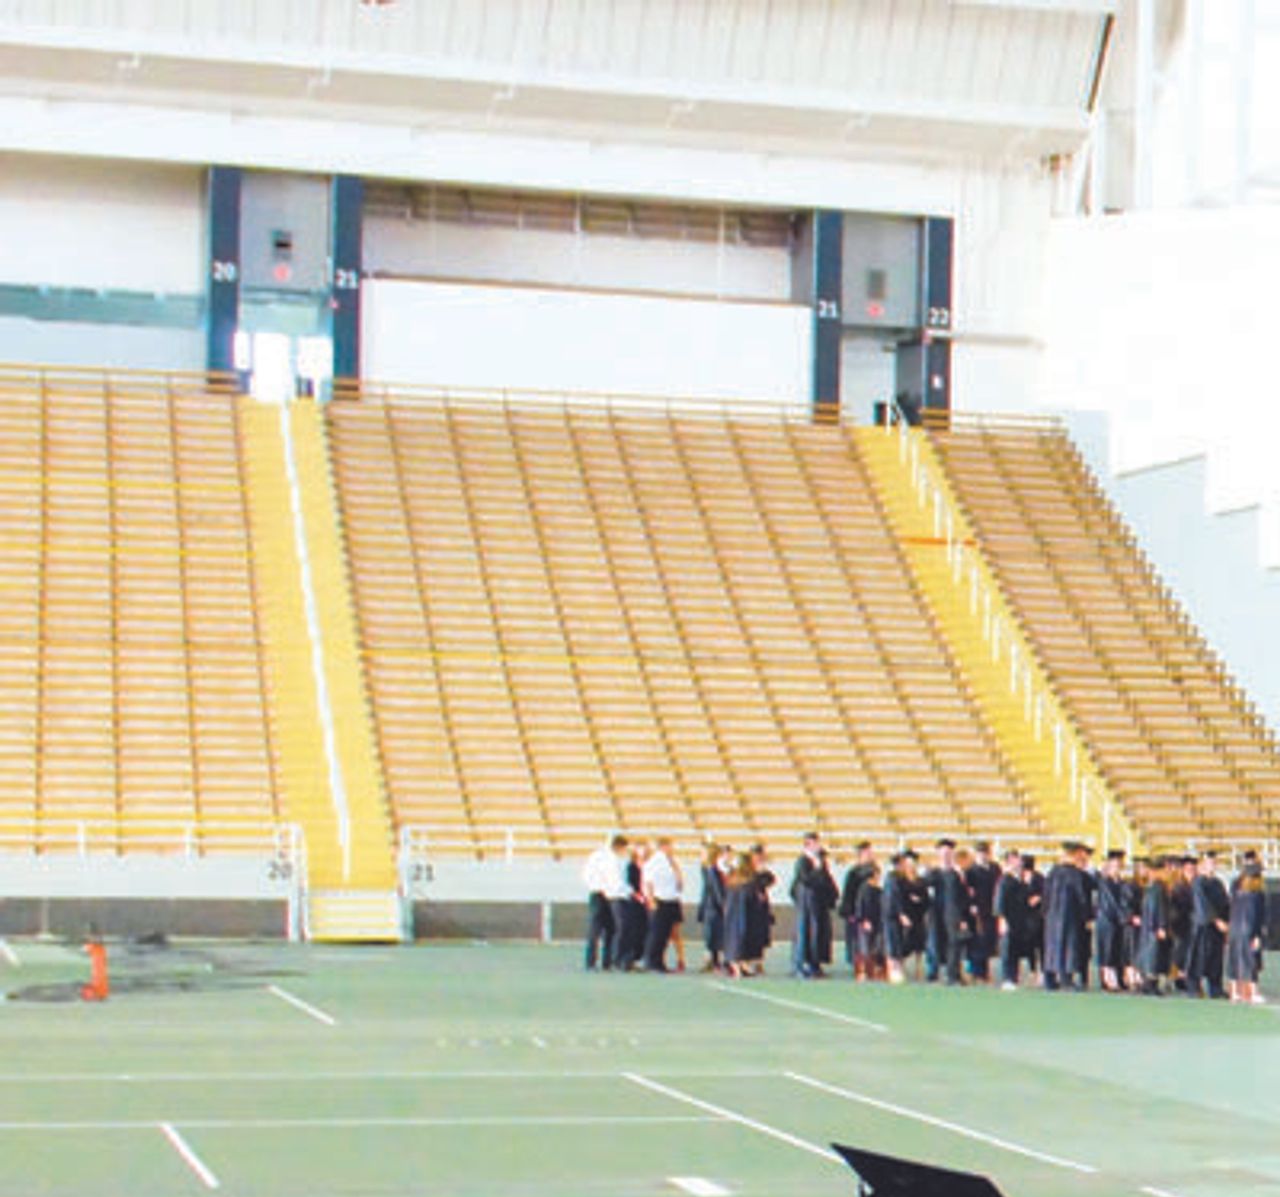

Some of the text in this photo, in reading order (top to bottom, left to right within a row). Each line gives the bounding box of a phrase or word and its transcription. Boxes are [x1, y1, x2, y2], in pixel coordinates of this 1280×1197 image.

[335, 268, 357, 289] 21
[818, 300, 837, 318] 21
[928, 307, 949, 325] 22
